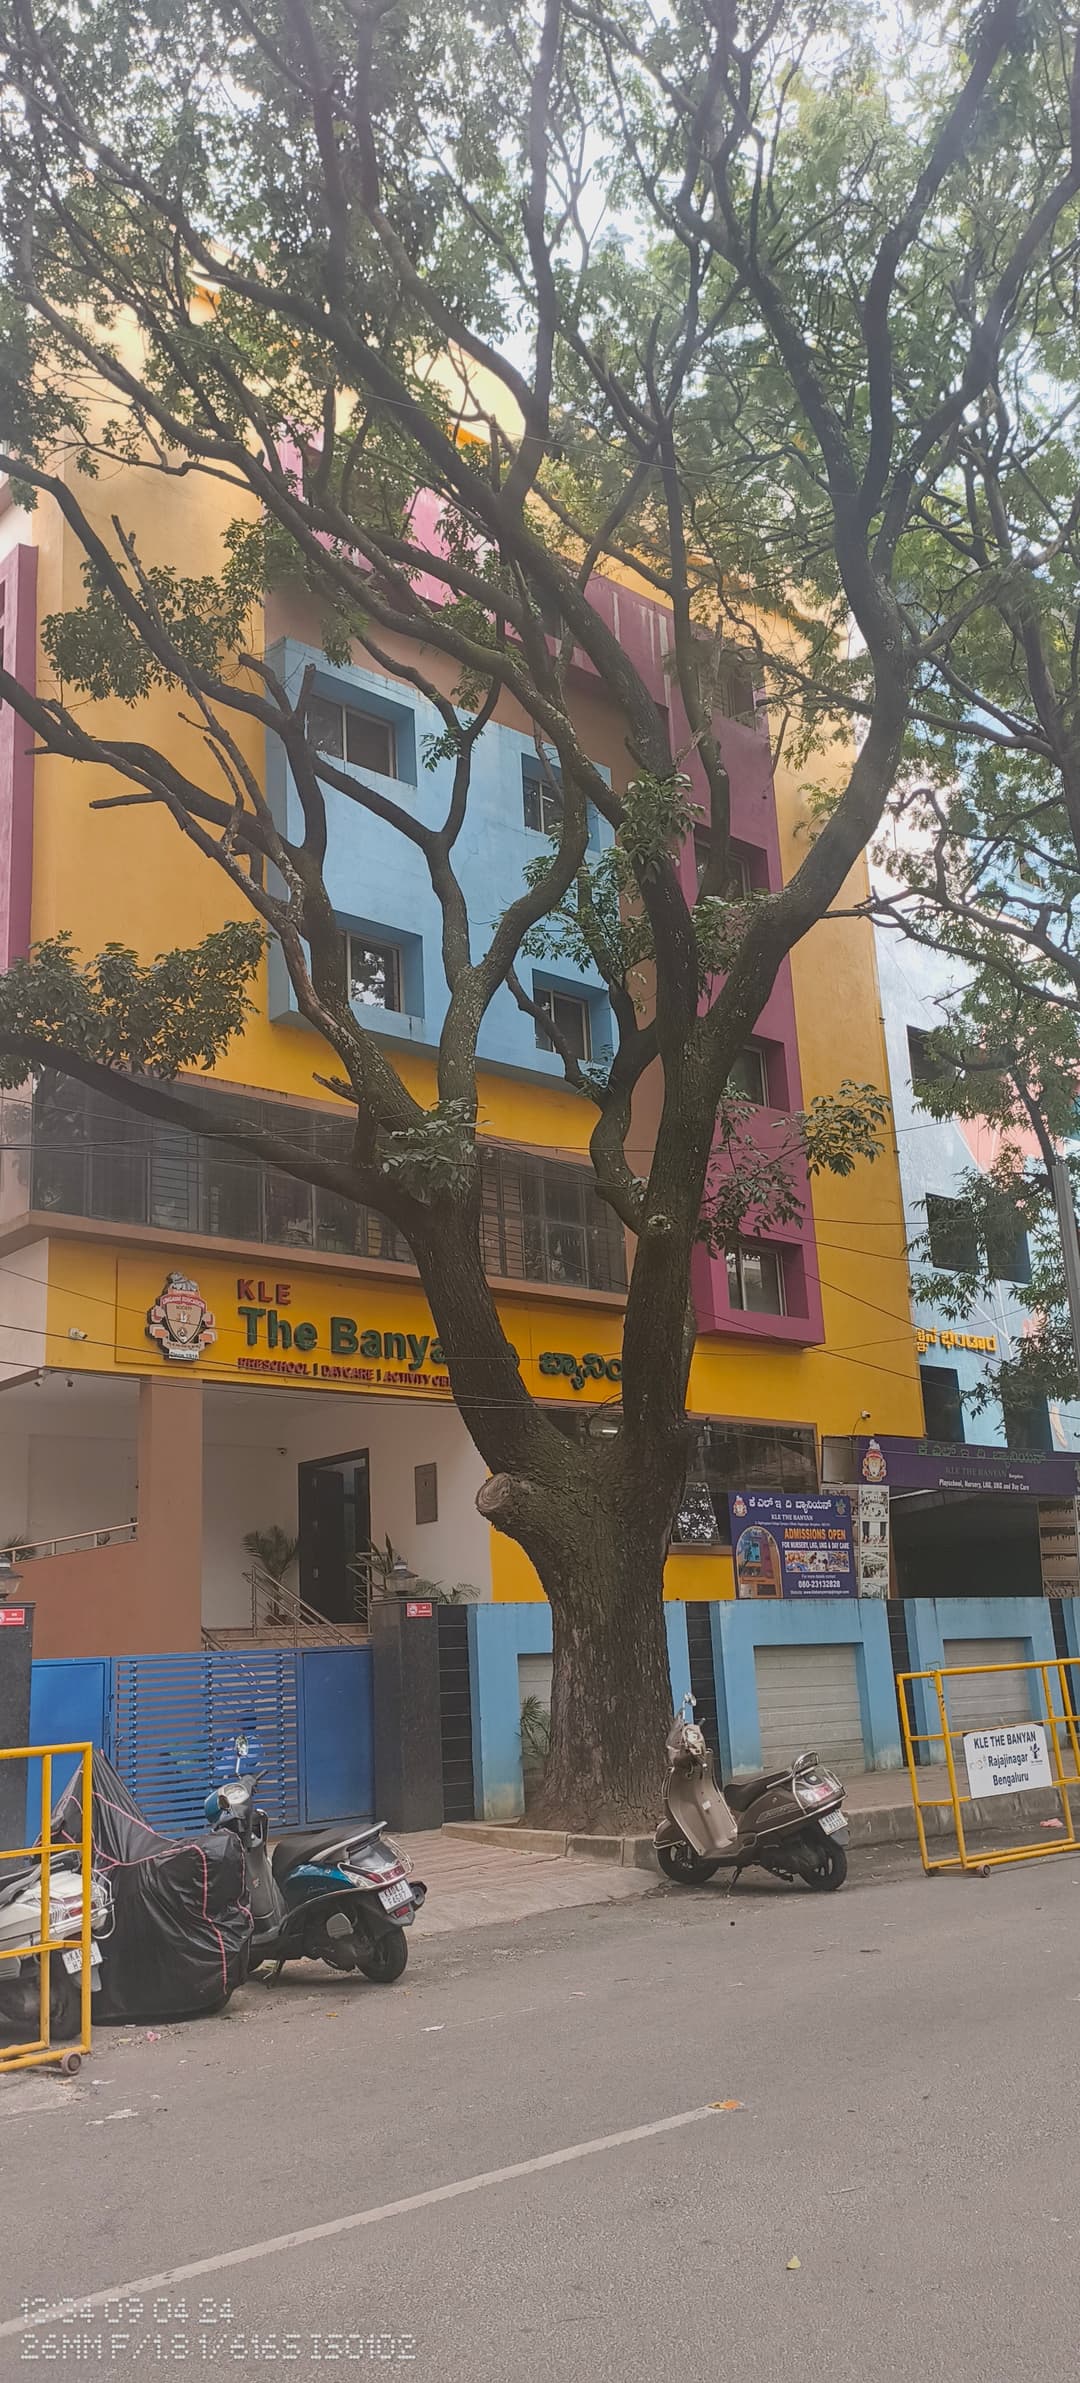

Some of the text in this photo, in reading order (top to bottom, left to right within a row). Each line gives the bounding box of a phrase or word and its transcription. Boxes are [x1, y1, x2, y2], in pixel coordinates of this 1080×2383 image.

[237, 1278, 291, 1306] KLE
[237, 1306, 449, 1370] The Banya
[237, 1358, 309, 1375] PRESCHOOL
[321, 1365, 374, 1380] DAYCARE
[383, 1371, 430, 1385] ACTIVITY
[784, 1528, 846, 1540] ADMISSIONS OPEN
[973, 1731, 1037, 1750] KLE THE BANYAN
[987, 1753, 1029, 1769] Rajajinagar
[992, 1771, 1030, 1787] Bengaluru
